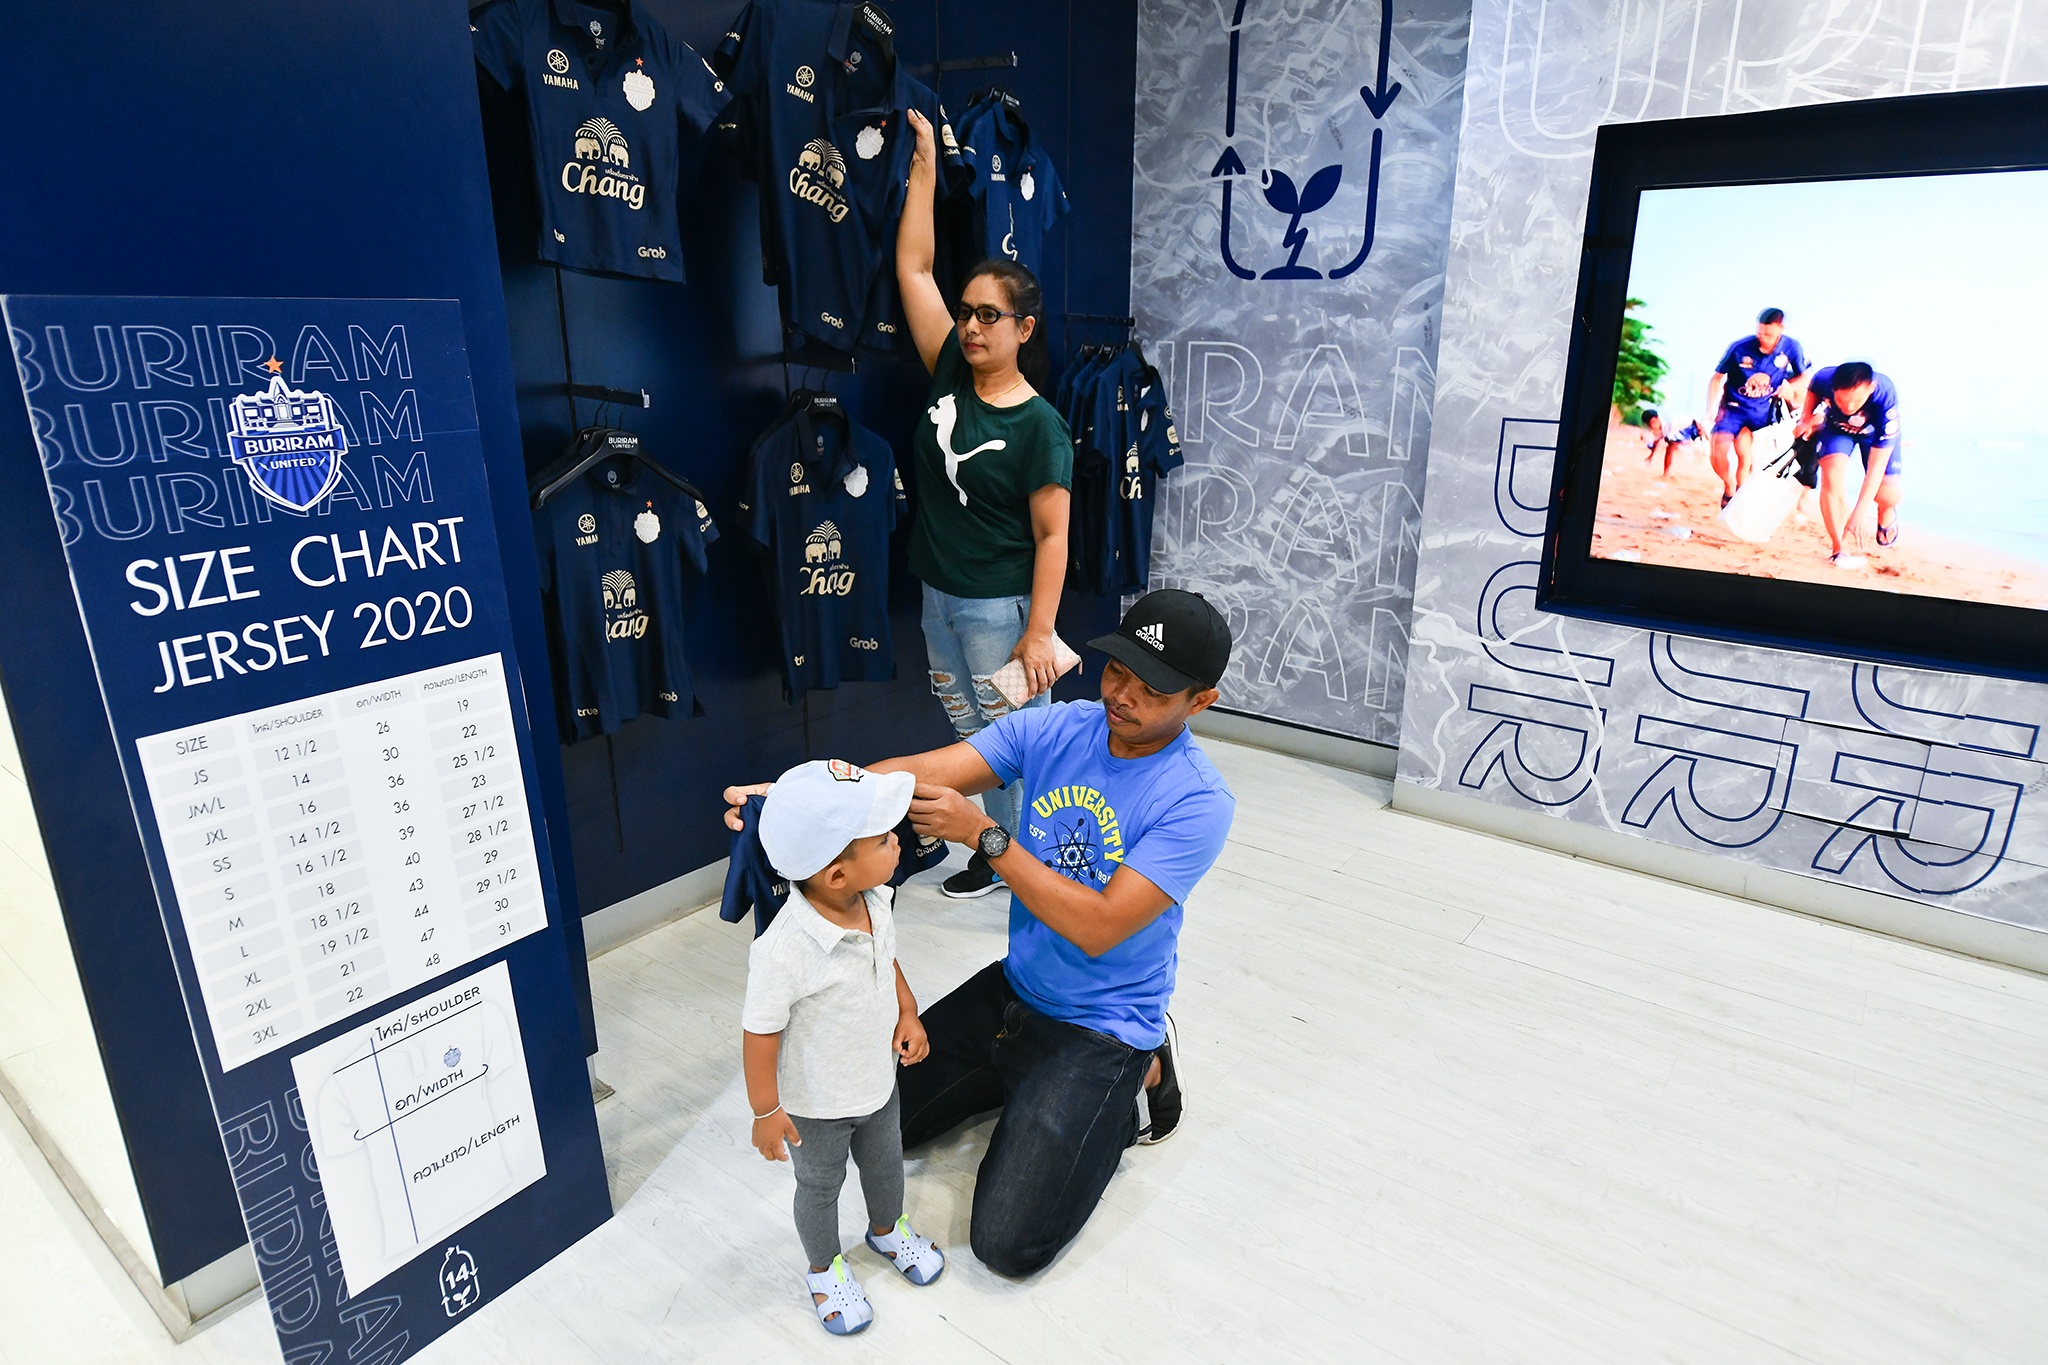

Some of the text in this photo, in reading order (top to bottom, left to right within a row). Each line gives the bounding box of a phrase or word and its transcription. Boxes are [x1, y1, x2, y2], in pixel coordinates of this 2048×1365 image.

[863, 6, 893, 35] BURIRAM
[542, 74, 579, 90] YAMAHA
[786, 83, 815, 103] YAMAHA
[561, 161, 645, 210] Chang
[789, 167, 850, 223] Chang
[637, 246, 667, 259] Grab
[820, 312, 845, 329] Grab
[30, 389, 424, 470] BURIM
[246, 433, 334, 455] BURIRAM
[270, 457, 317, 470] UNITED
[125, 517, 464, 616] SIZE CHART
[153, 586, 473, 693] JERSEY 2020
[849, 637, 879, 650] Grab
[1135, 629, 1165, 651] adidas
[458, 699, 468, 711] 19
[577, 708, 598, 717] true
[377, 721, 389, 734] 26
[462, 725, 477, 738] 22
[176, 736, 208, 755] SIZE
[275, 740, 316, 761] 12 1/2
[383, 747, 398, 761] 30
[453, 746, 494, 768] 25 1/2
[194, 770, 208, 785] JS
[293, 773, 310, 786] 14
[388, 774, 404, 788] 36
[472, 775, 486, 788] 23
[189, 797, 225, 819] JM/L
[299, 801, 316, 814] 16
[394, 800, 409, 813] 36
[463, 795, 503, 818] 27 1/2
[467, 820, 508, 843] 28 1/2
[1031, 785, 1124, 864] UNIVERSITY
[206, 829, 227, 845] JXL
[290, 822, 340, 846] 14 1/2
[399, 826, 414, 840] 39
[213, 857, 231, 872] SS
[296, 849, 346, 874] 16 1/2
[406, 852, 420, 865] 40
[484, 850, 498, 864] 29
[409, 878, 423, 892] 43
[477, 869, 516, 893] 29 1/2
[225, 888, 234, 900] S
[319, 883, 334, 897] 18
[415, 905, 428, 917] 44
[495, 898, 508, 911] 30
[311, 902, 360, 929] 18 1/2
[230, 918, 243, 931] M
[499, 922, 511, 935] 31
[321, 928, 369, 955] 19 1/2
[421, 928, 434, 942] 47
[241, 946, 249, 957] L
[426, 954, 440, 967] 48
[341, 962, 355, 976] 21
[245, 972, 261, 987] XL
[347, 987, 363, 1002] 22
[246, 999, 271, 1017] 2XL
[375, 986, 481, 1042] ไหล่/SHOULDER
[253, 1026, 278, 1044] 3XL
[395, 1069, 464, 1111] อก/WIDTH
[413, 1115, 521, 1184] ความยาว/LENGTH
[445, 1262, 470, 1290] 14
